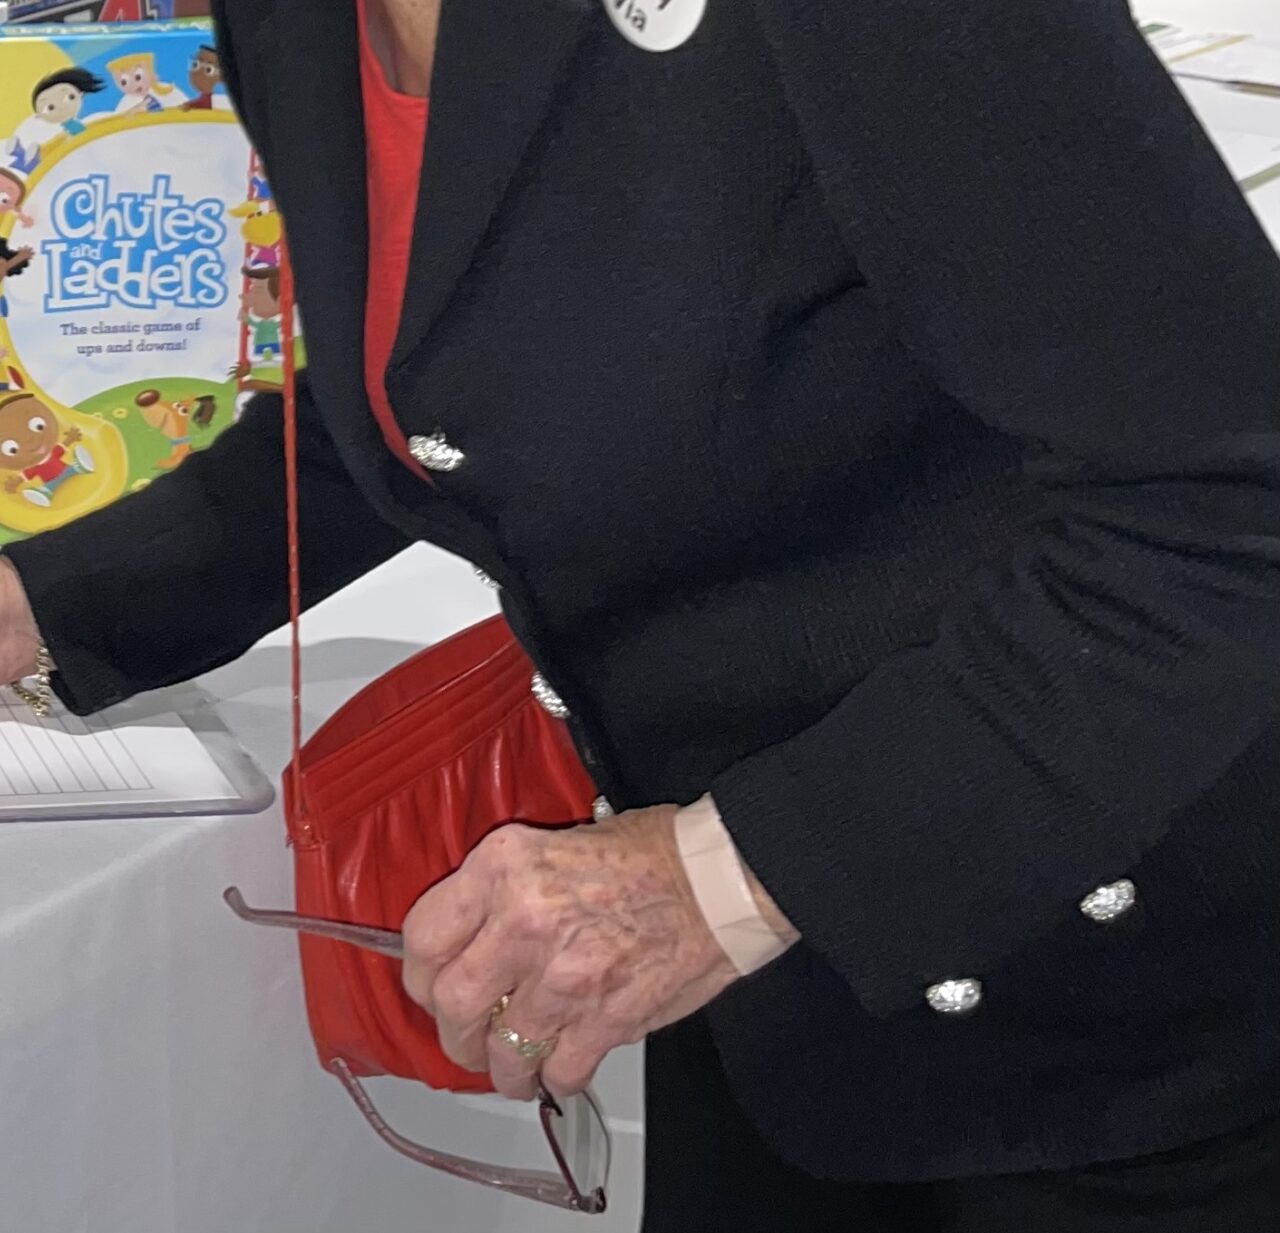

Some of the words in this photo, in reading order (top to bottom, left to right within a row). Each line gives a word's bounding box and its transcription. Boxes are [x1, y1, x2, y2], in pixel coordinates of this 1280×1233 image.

[53, 175, 226, 251] Chutes
[70, 242, 103, 260] and
[44, 240, 228, 313] Ladders
[60, 322, 88, 336] The
[90, 320, 140, 335] classic
[143, 321, 174, 337] game
[177, 318, 202, 333] of
[77, 344, 103, 357] ups
[106, 340, 133, 354] and
[136, 337, 187, 353] downs!
